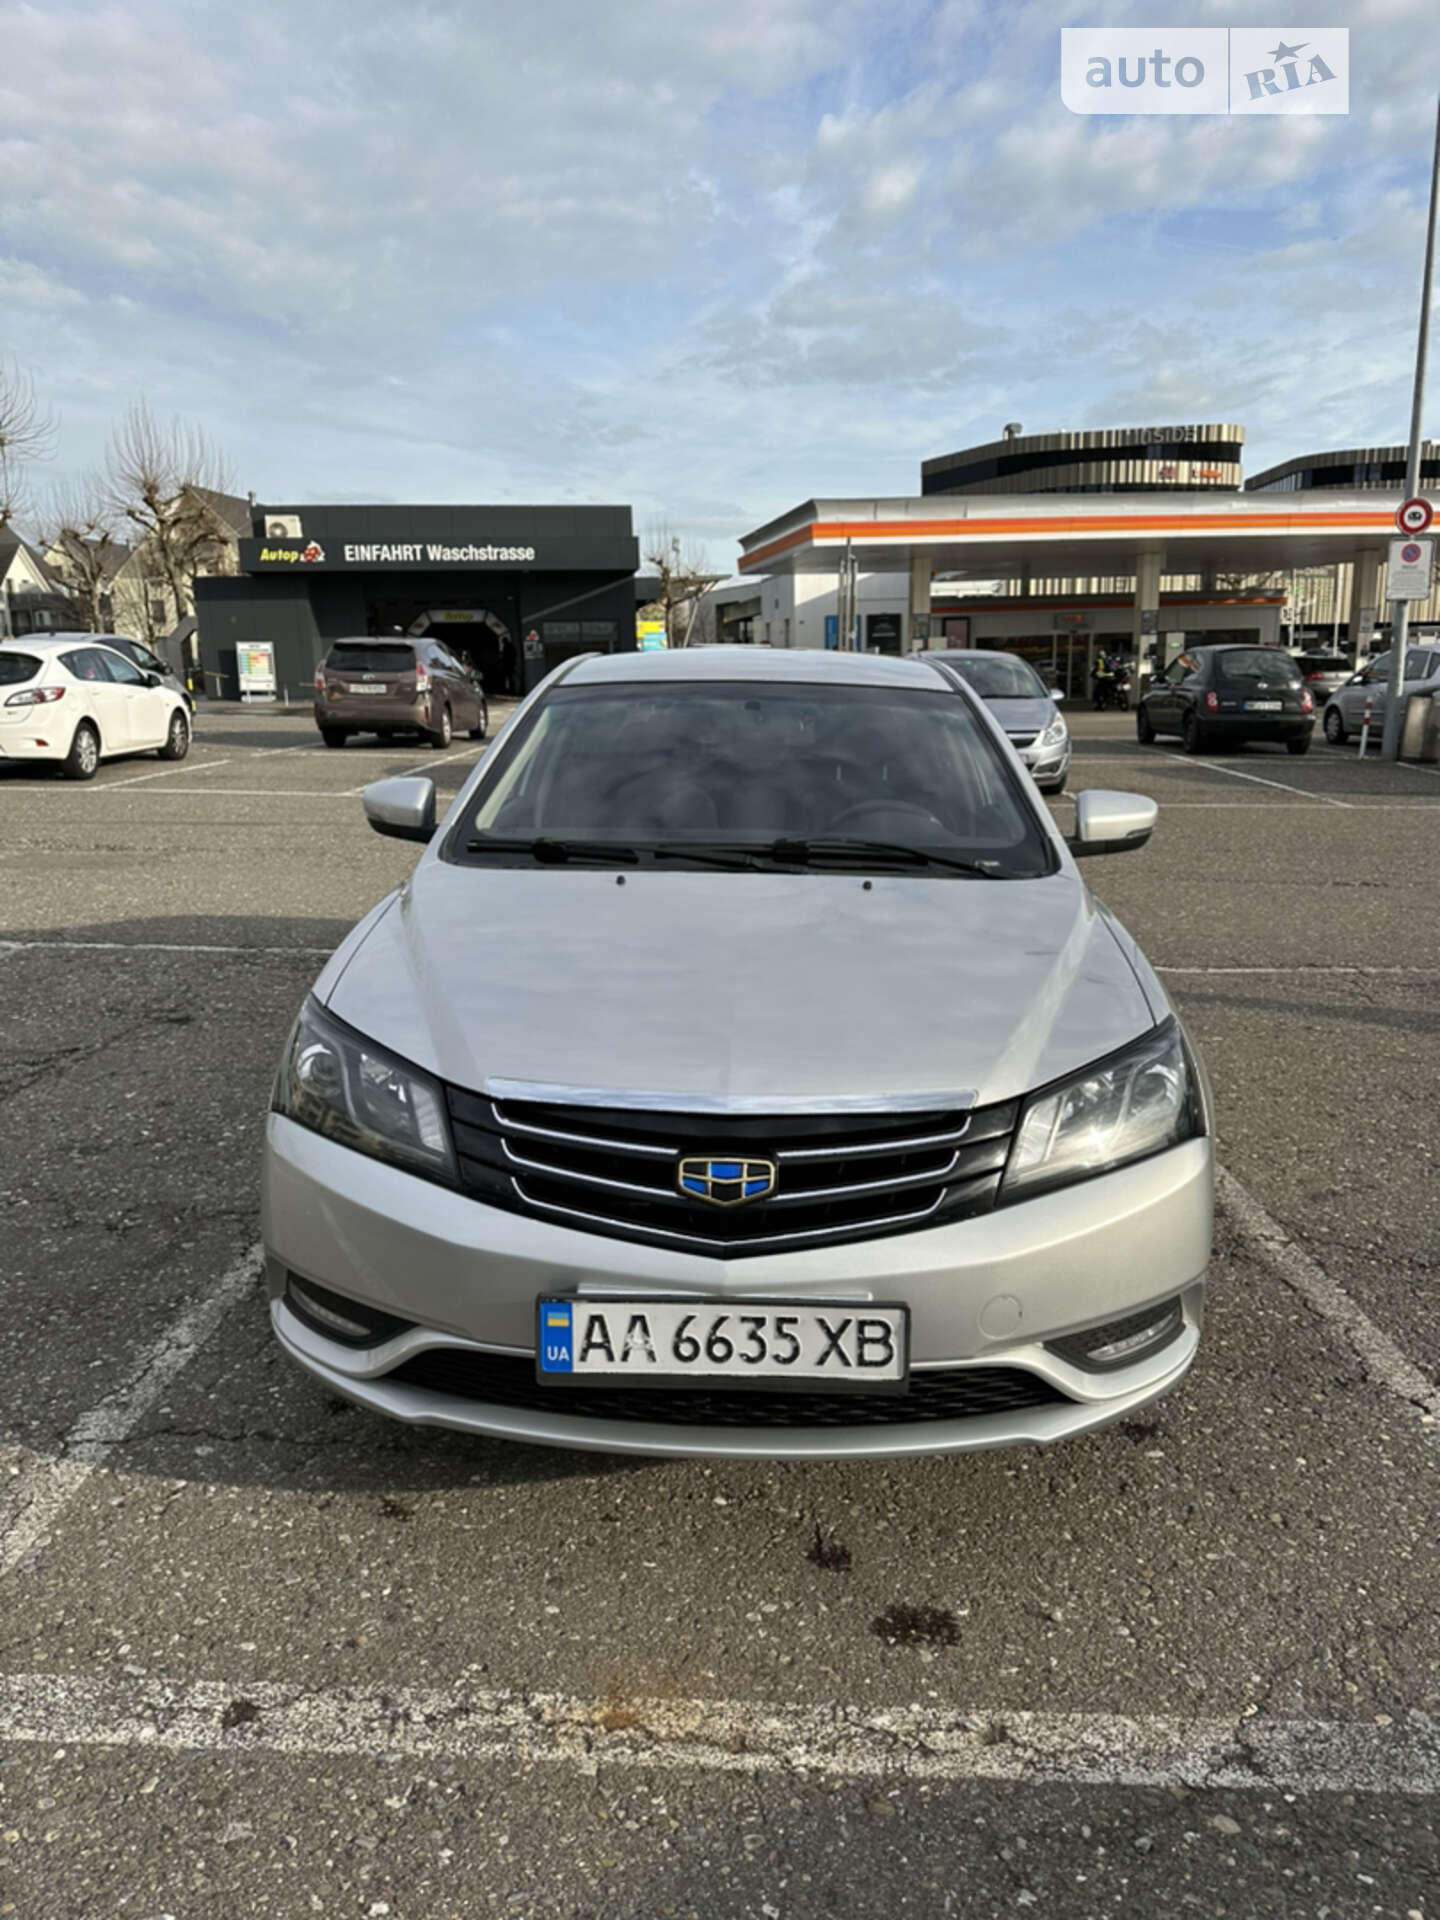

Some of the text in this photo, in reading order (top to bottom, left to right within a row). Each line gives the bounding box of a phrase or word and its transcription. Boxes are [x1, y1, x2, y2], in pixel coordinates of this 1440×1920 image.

[260, 548, 299, 563] Autop
[344, 544, 535, 562] EINFAHRT Waschstrasse
[579, 1314, 894, 1368] AA 6635 XB
[547, 1347, 570, 1361] UA
